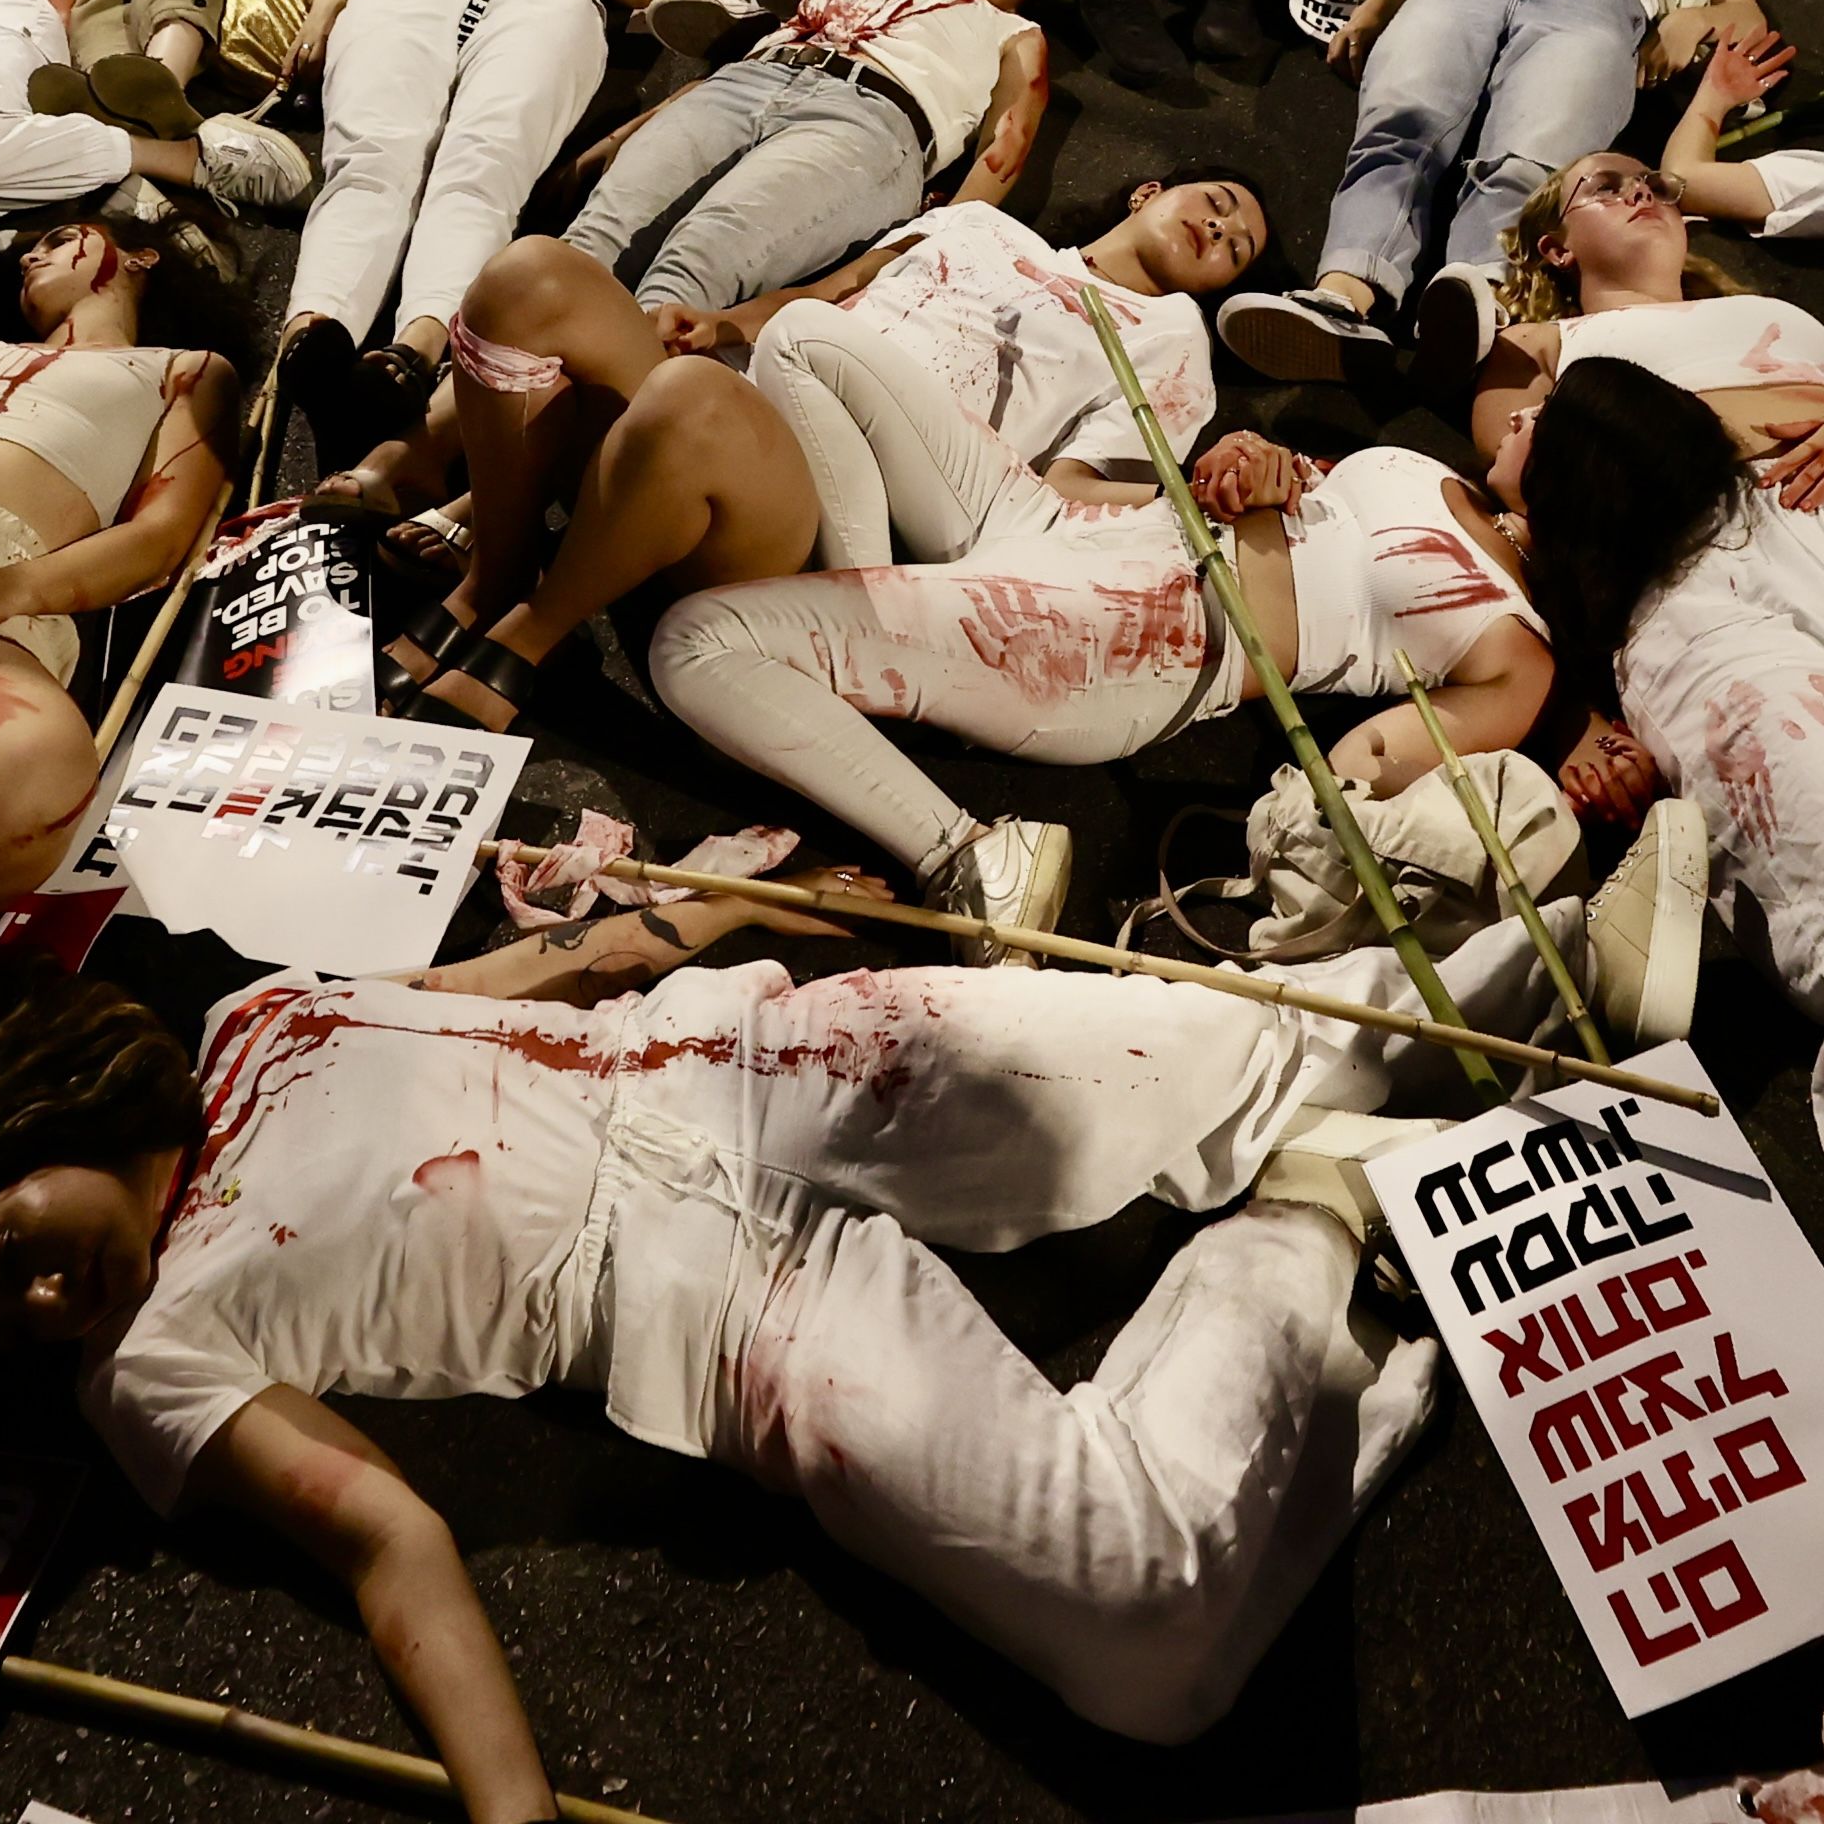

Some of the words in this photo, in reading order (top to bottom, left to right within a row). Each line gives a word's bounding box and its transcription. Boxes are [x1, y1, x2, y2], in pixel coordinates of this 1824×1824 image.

[210, 561, 359, 625] SAVED.
[230, 604, 287, 651] BE
[296, 589, 360, 623] TO
[166, 713, 258, 814] שלנו
[340, 743, 447, 876] עסקה
[396, 749, 496, 896] עכשיו.
[1414, 1097, 1645, 1239] עכשיו.
[1449, 1172, 1694, 1316] עסקה
[1480, 1248, 1711, 1398] אותם.
[1528, 1331, 1790, 1484] שנציל
[1562, 1416, 1807, 1573] מתים
[1606, 1539, 1769, 1667] הם
